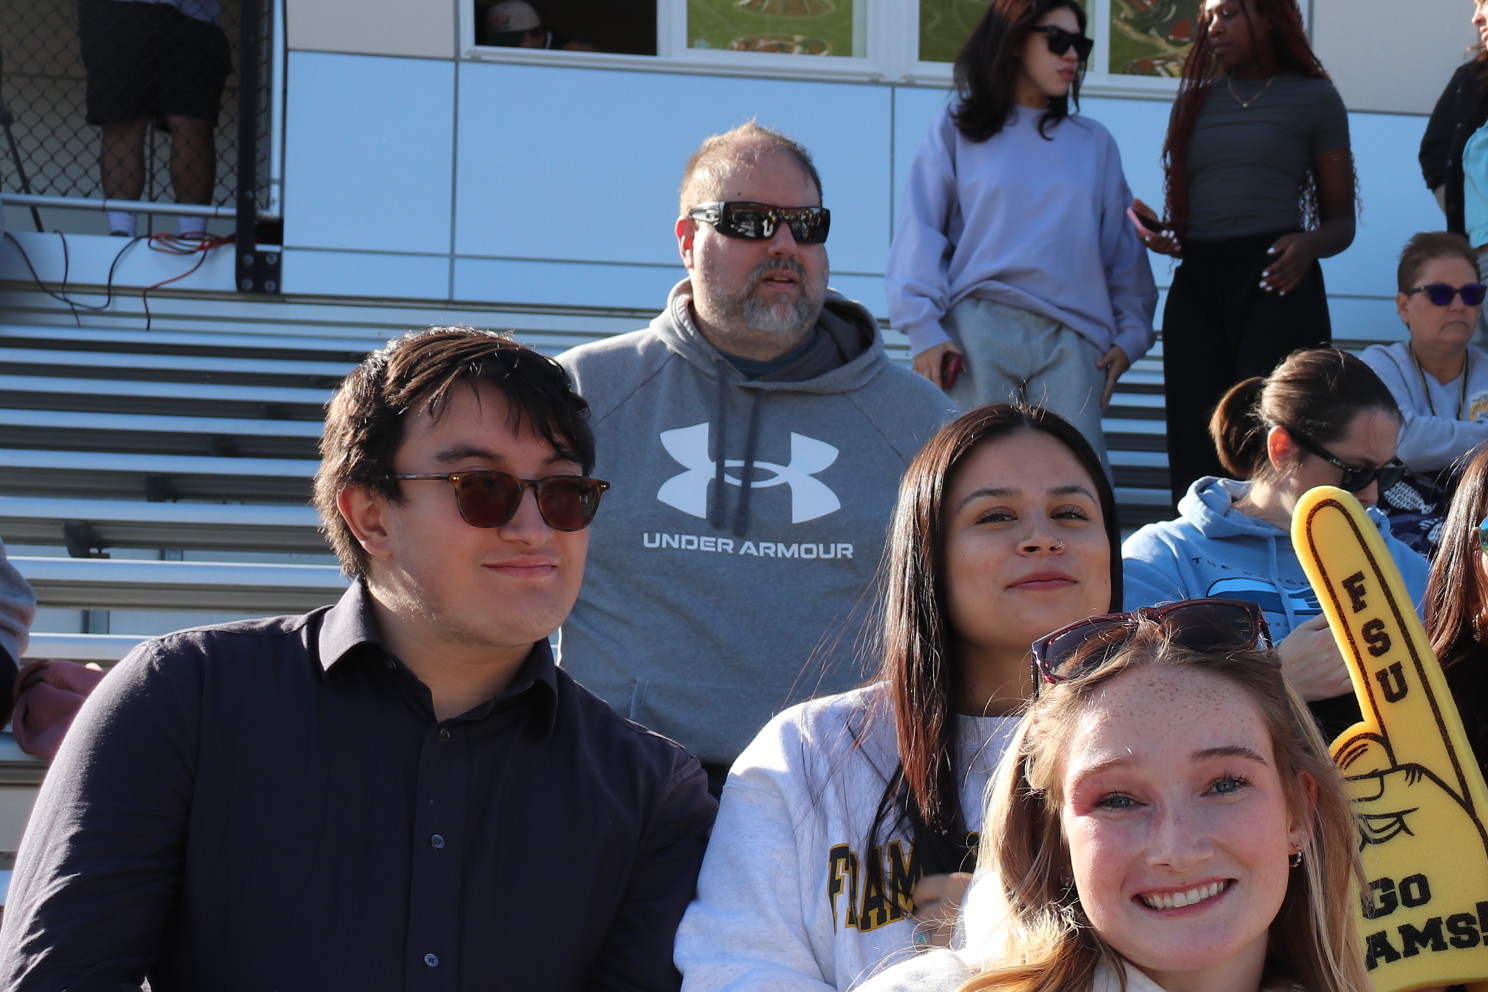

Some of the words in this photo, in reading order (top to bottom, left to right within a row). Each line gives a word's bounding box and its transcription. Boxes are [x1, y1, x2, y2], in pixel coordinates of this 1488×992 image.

[643, 532, 734, 554] UNDER
[739, 540, 854, 560] ARMOUR
[1341, 570, 1410, 704] FSU
[1361, 873, 1432, 920] GO
